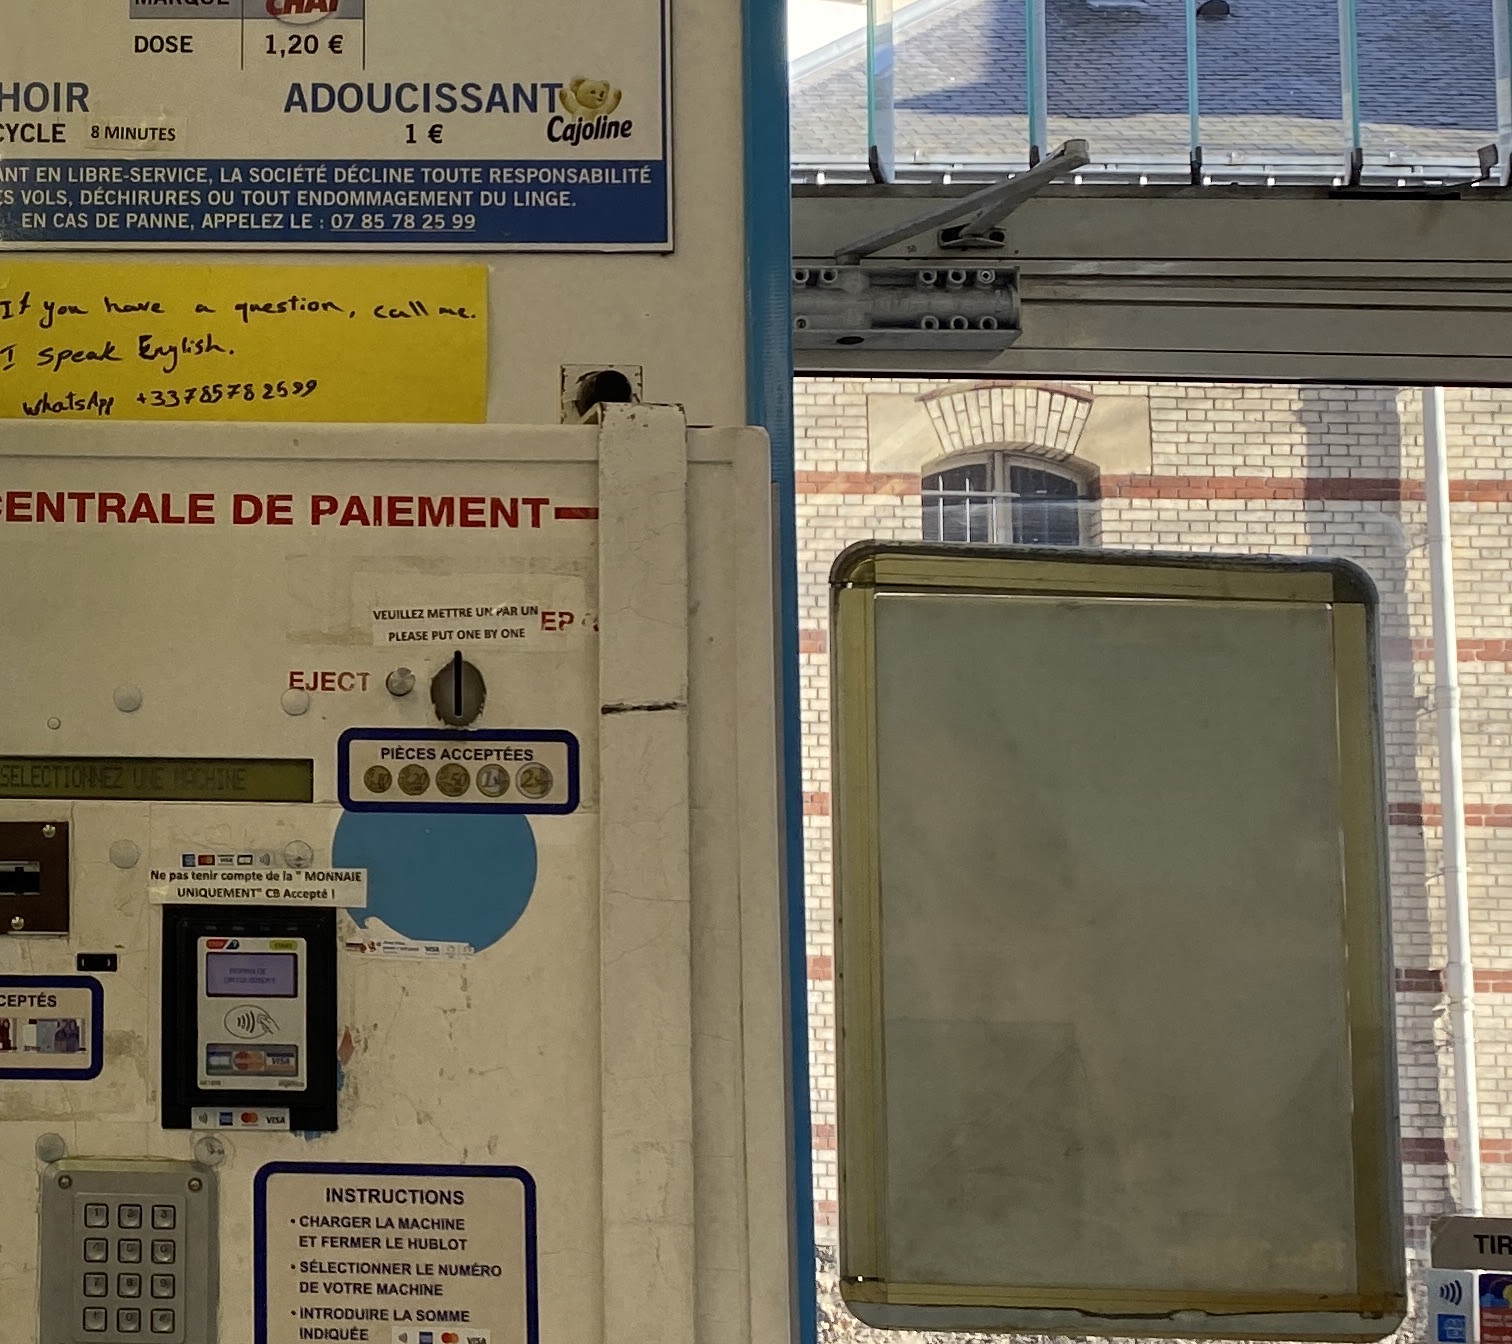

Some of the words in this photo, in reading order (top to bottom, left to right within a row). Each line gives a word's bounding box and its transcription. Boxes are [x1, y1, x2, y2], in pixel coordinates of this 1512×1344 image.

[135, 36, 193, 53] DOSE
[266, 35, 318, 58] 1,20
[328, 35, 343, 54] €
[284, 83, 564, 113] ADOUCISSANT
[91, 126, 99, 138] 8
[105, 126, 175, 141] MINUTES
[547, 114, 632, 147] Cajoline
[37, 167, 60, 183] EN
[68, 166, 213, 186] LIBRE-SERVICE,
[221, 167, 242, 183] LA
[250, 164, 327, 184] SOCIÉTÉ
[334, 164, 415, 184] DÉCLINE
[422, 167, 483, 184] TOUTE
[489, 164, 651, 185] RESPONSABILITÉ
[21, 190, 73, 208] VOLS,
[80, 186, 201, 206] DÉCHIRURES
[208, 190, 236, 206] OU
[242, 190, 290, 207] TOUT
[297, 190, 473, 207] ENDOMMAGEMENT
[480, 190, 507, 207] DU
[514, 191, 577, 207] LINGE.
[21, 212, 46, 229] EN
[52, 212, 88, 229] CAS
[95, 213, 120, 229] DE
[126, 213, 194, 231] PANNE,
[201, 213, 284, 230] APPELEZ
[290, 213, 313, 230] LE
[331, 213, 354, 230] 07
[361, 213, 385, 230] 85
[392, 213, 416, 230] 78
[422, 213, 446, 230] 25
[452, 213, 476, 230] 99
[39, 301, 88, 328] you
[104, 297, 164, 313] have
[195, 304, 215, 313] a
[235, 296, 355, 323] question,
[374, 301, 428, 318] call
[0, 345, 15, 370] I
[37, 341, 122, 370] speak
[233, 494, 293, 525] DE
[312, 495, 549, 528] PAIEMENT
[373, 609, 424, 621] VEUILLEZ
[427, 607, 473, 619] METTRE
[496, 605, 518, 617] PAR
[521, 605, 538, 616] UN
[388, 630, 428, 642] PLEASE
[432, 629, 454, 641] PUT
[457, 629, 481, 641] ONE
[484, 629, 500, 640] BY
[501, 628, 526, 639] ONE
[288, 670, 371, 692] EJECT
[380, 744, 436, 760] PIÈCES
[440, 745, 534, 762] ACCEPTÉES
[151, 869, 167, 881] Ne
[169, 871, 189, 883] pas
[191, 869, 218, 881] tenir
[220, 871, 263, 883] compte
[265, 869, 280, 881] de
[282, 870, 293, 881] la
[304, 870, 362, 882] MONNAIE
[265, 887, 281, 899] CB
[283, 886, 328, 900] Accepté
[265, 1115, 286, 1125] VISA
[325, 1187, 465, 1205] INSTRUCTIONS
[299, 1215, 371, 1229] CHARGER
[376, 1217, 394, 1229] LA
[398, 1217, 465, 1231] MACHINE
[299, 1259, 411, 1275] SÉLECTIONNER
[416, 1264, 434, 1276] LE
[438, 1262, 502, 1278] NUMÉRO
[299, 1307, 389, 1321] INTRODUIRE
[393, 1309, 412, 1321] LA
[416, 1309, 470, 1323] SOMME
[299, 1325, 369, 1341] INDIQUÉE
[466, 1336, 487, 1344] VISA
